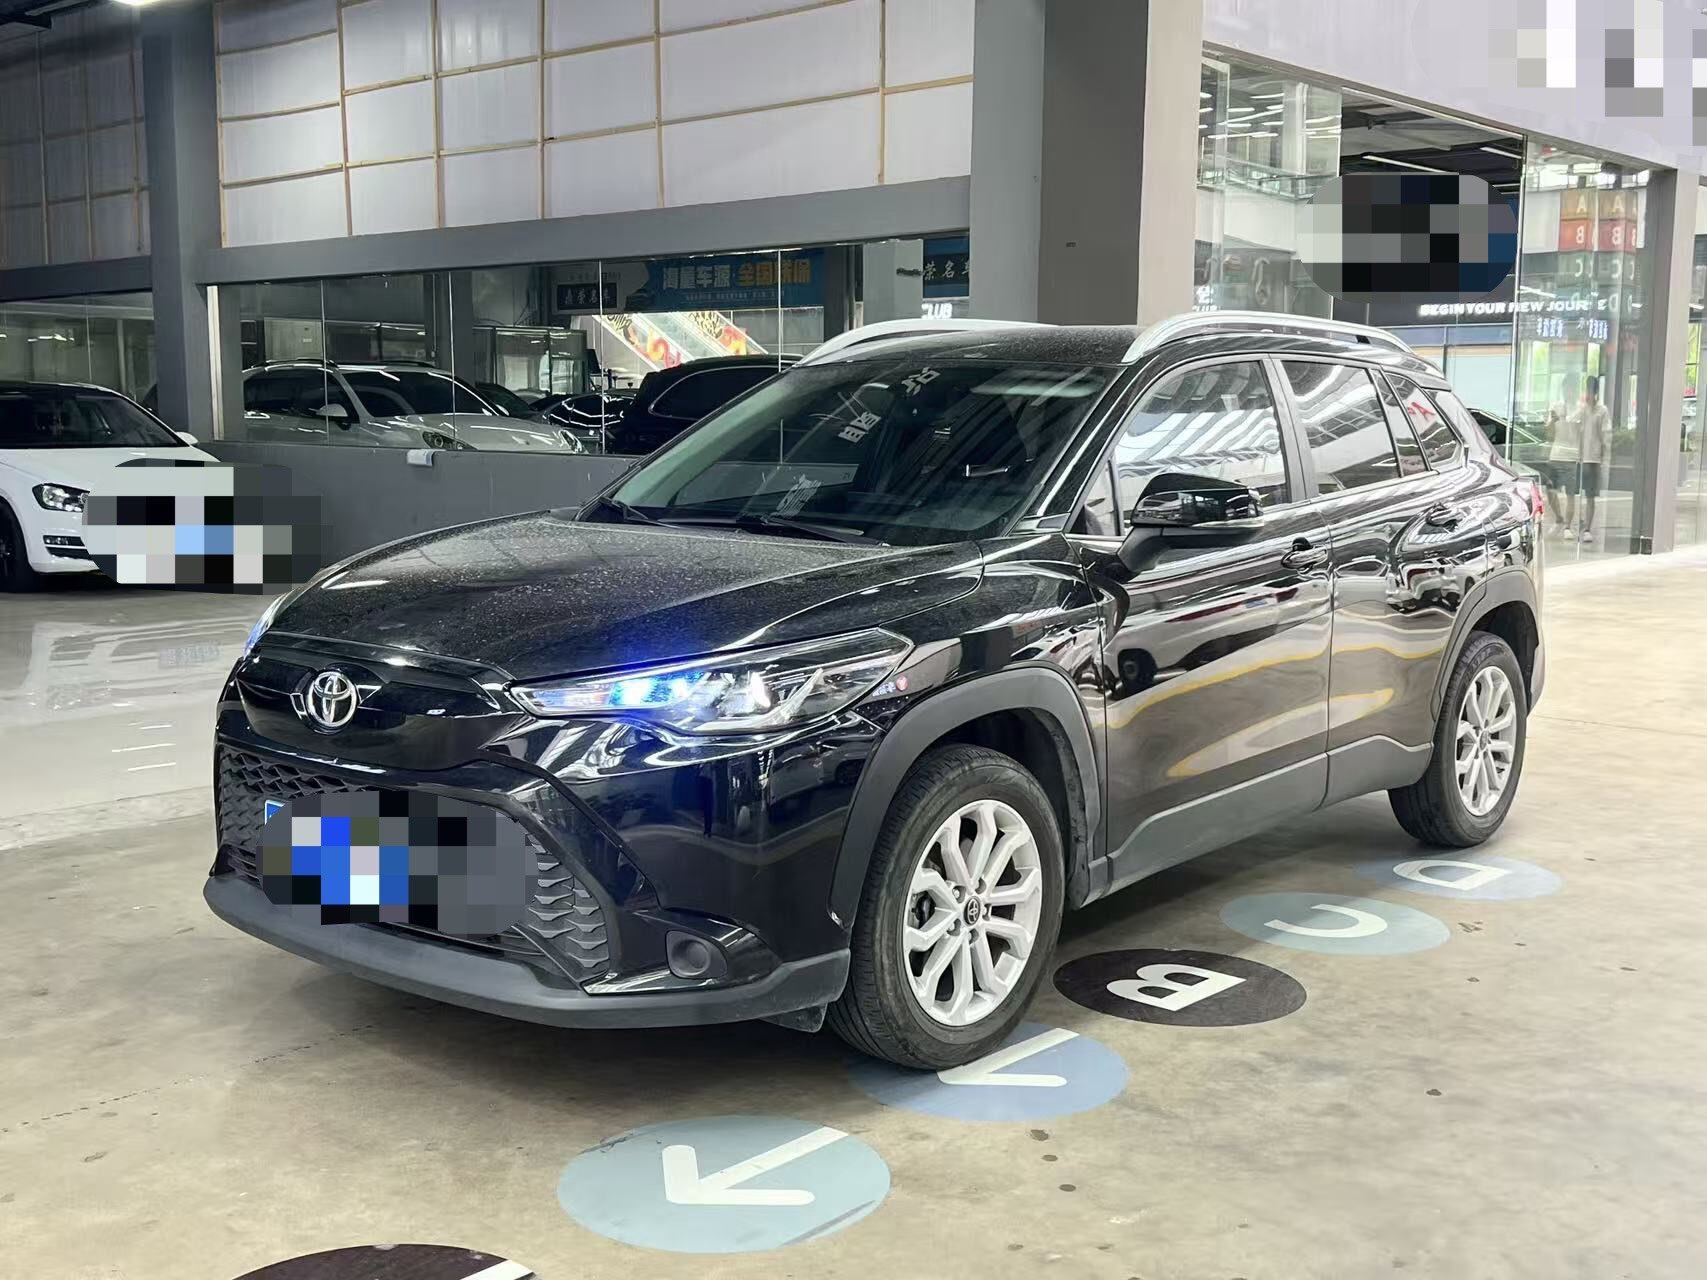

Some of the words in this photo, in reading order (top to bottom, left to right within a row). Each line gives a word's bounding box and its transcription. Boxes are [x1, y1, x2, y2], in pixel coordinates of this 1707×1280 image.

[1418, 303, 1464, 316] BEGIN
[1466, 302, 1506, 315] YOUR
[1508, 301, 1544, 314] NEW
[1106, 963, 1247, 1012] B
